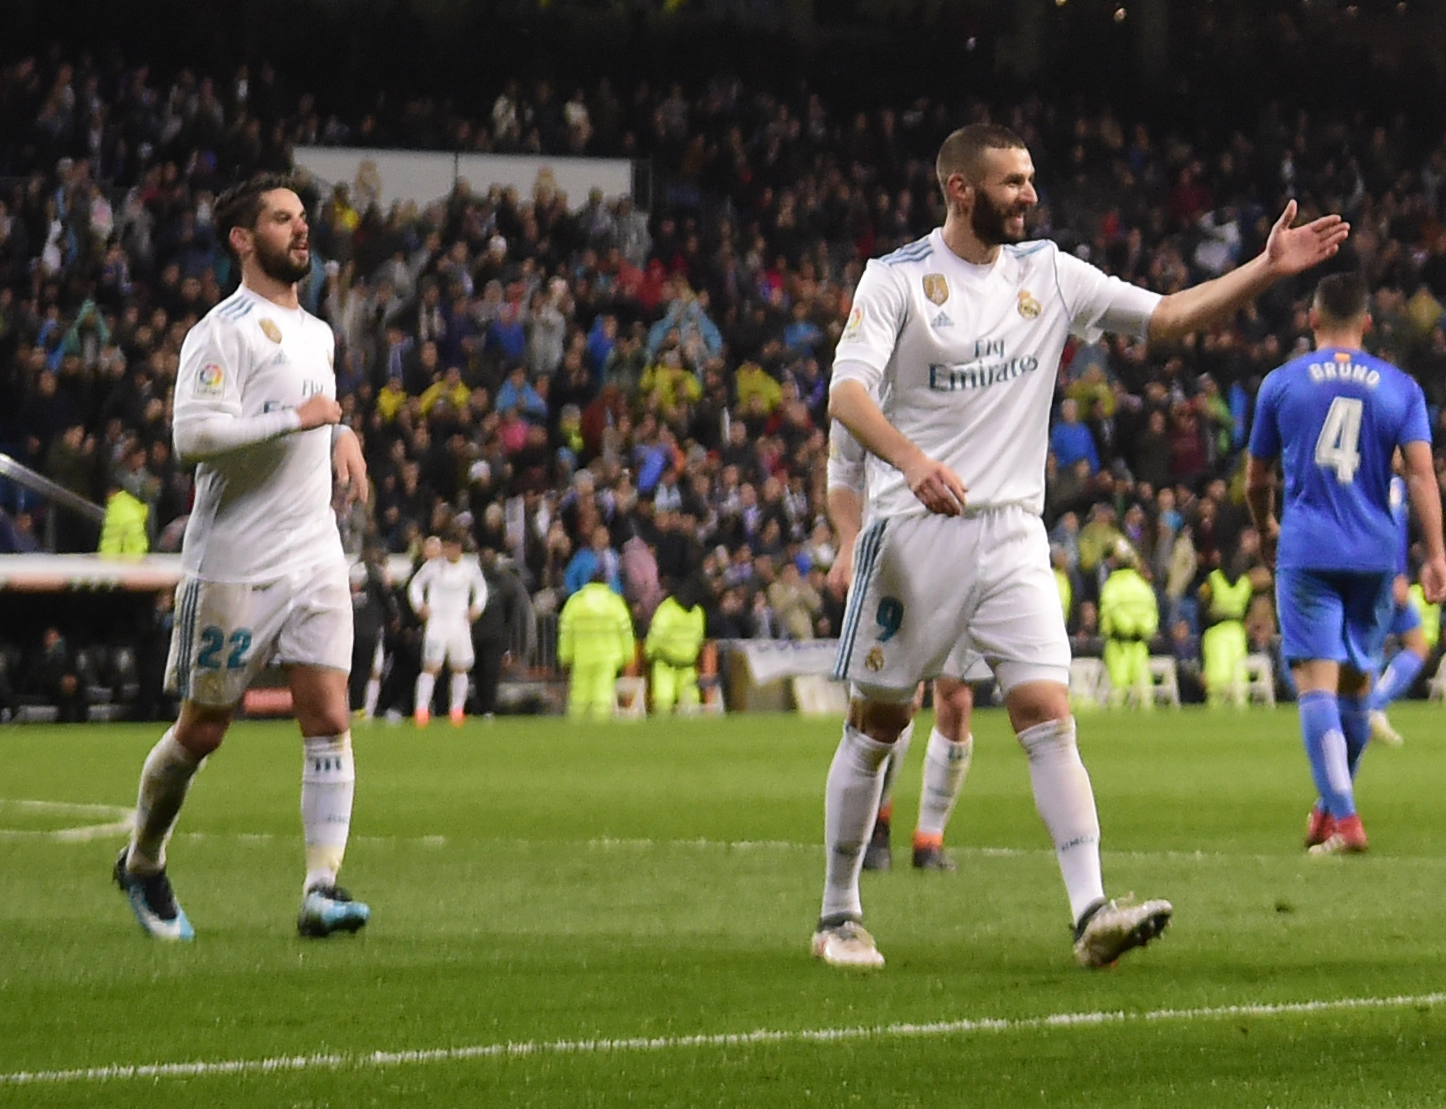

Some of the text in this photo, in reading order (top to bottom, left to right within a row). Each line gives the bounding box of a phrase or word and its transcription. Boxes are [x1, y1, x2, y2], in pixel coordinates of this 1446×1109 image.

[974, 339, 1005, 359] Fly
[929, 354, 1038, 390] Emirates
[1309, 362, 1381, 387] BRUNO
[1315, 396, 1363, 485] 4
[876, 596, 904, 643] 9
[198, 626, 252, 669] 22
